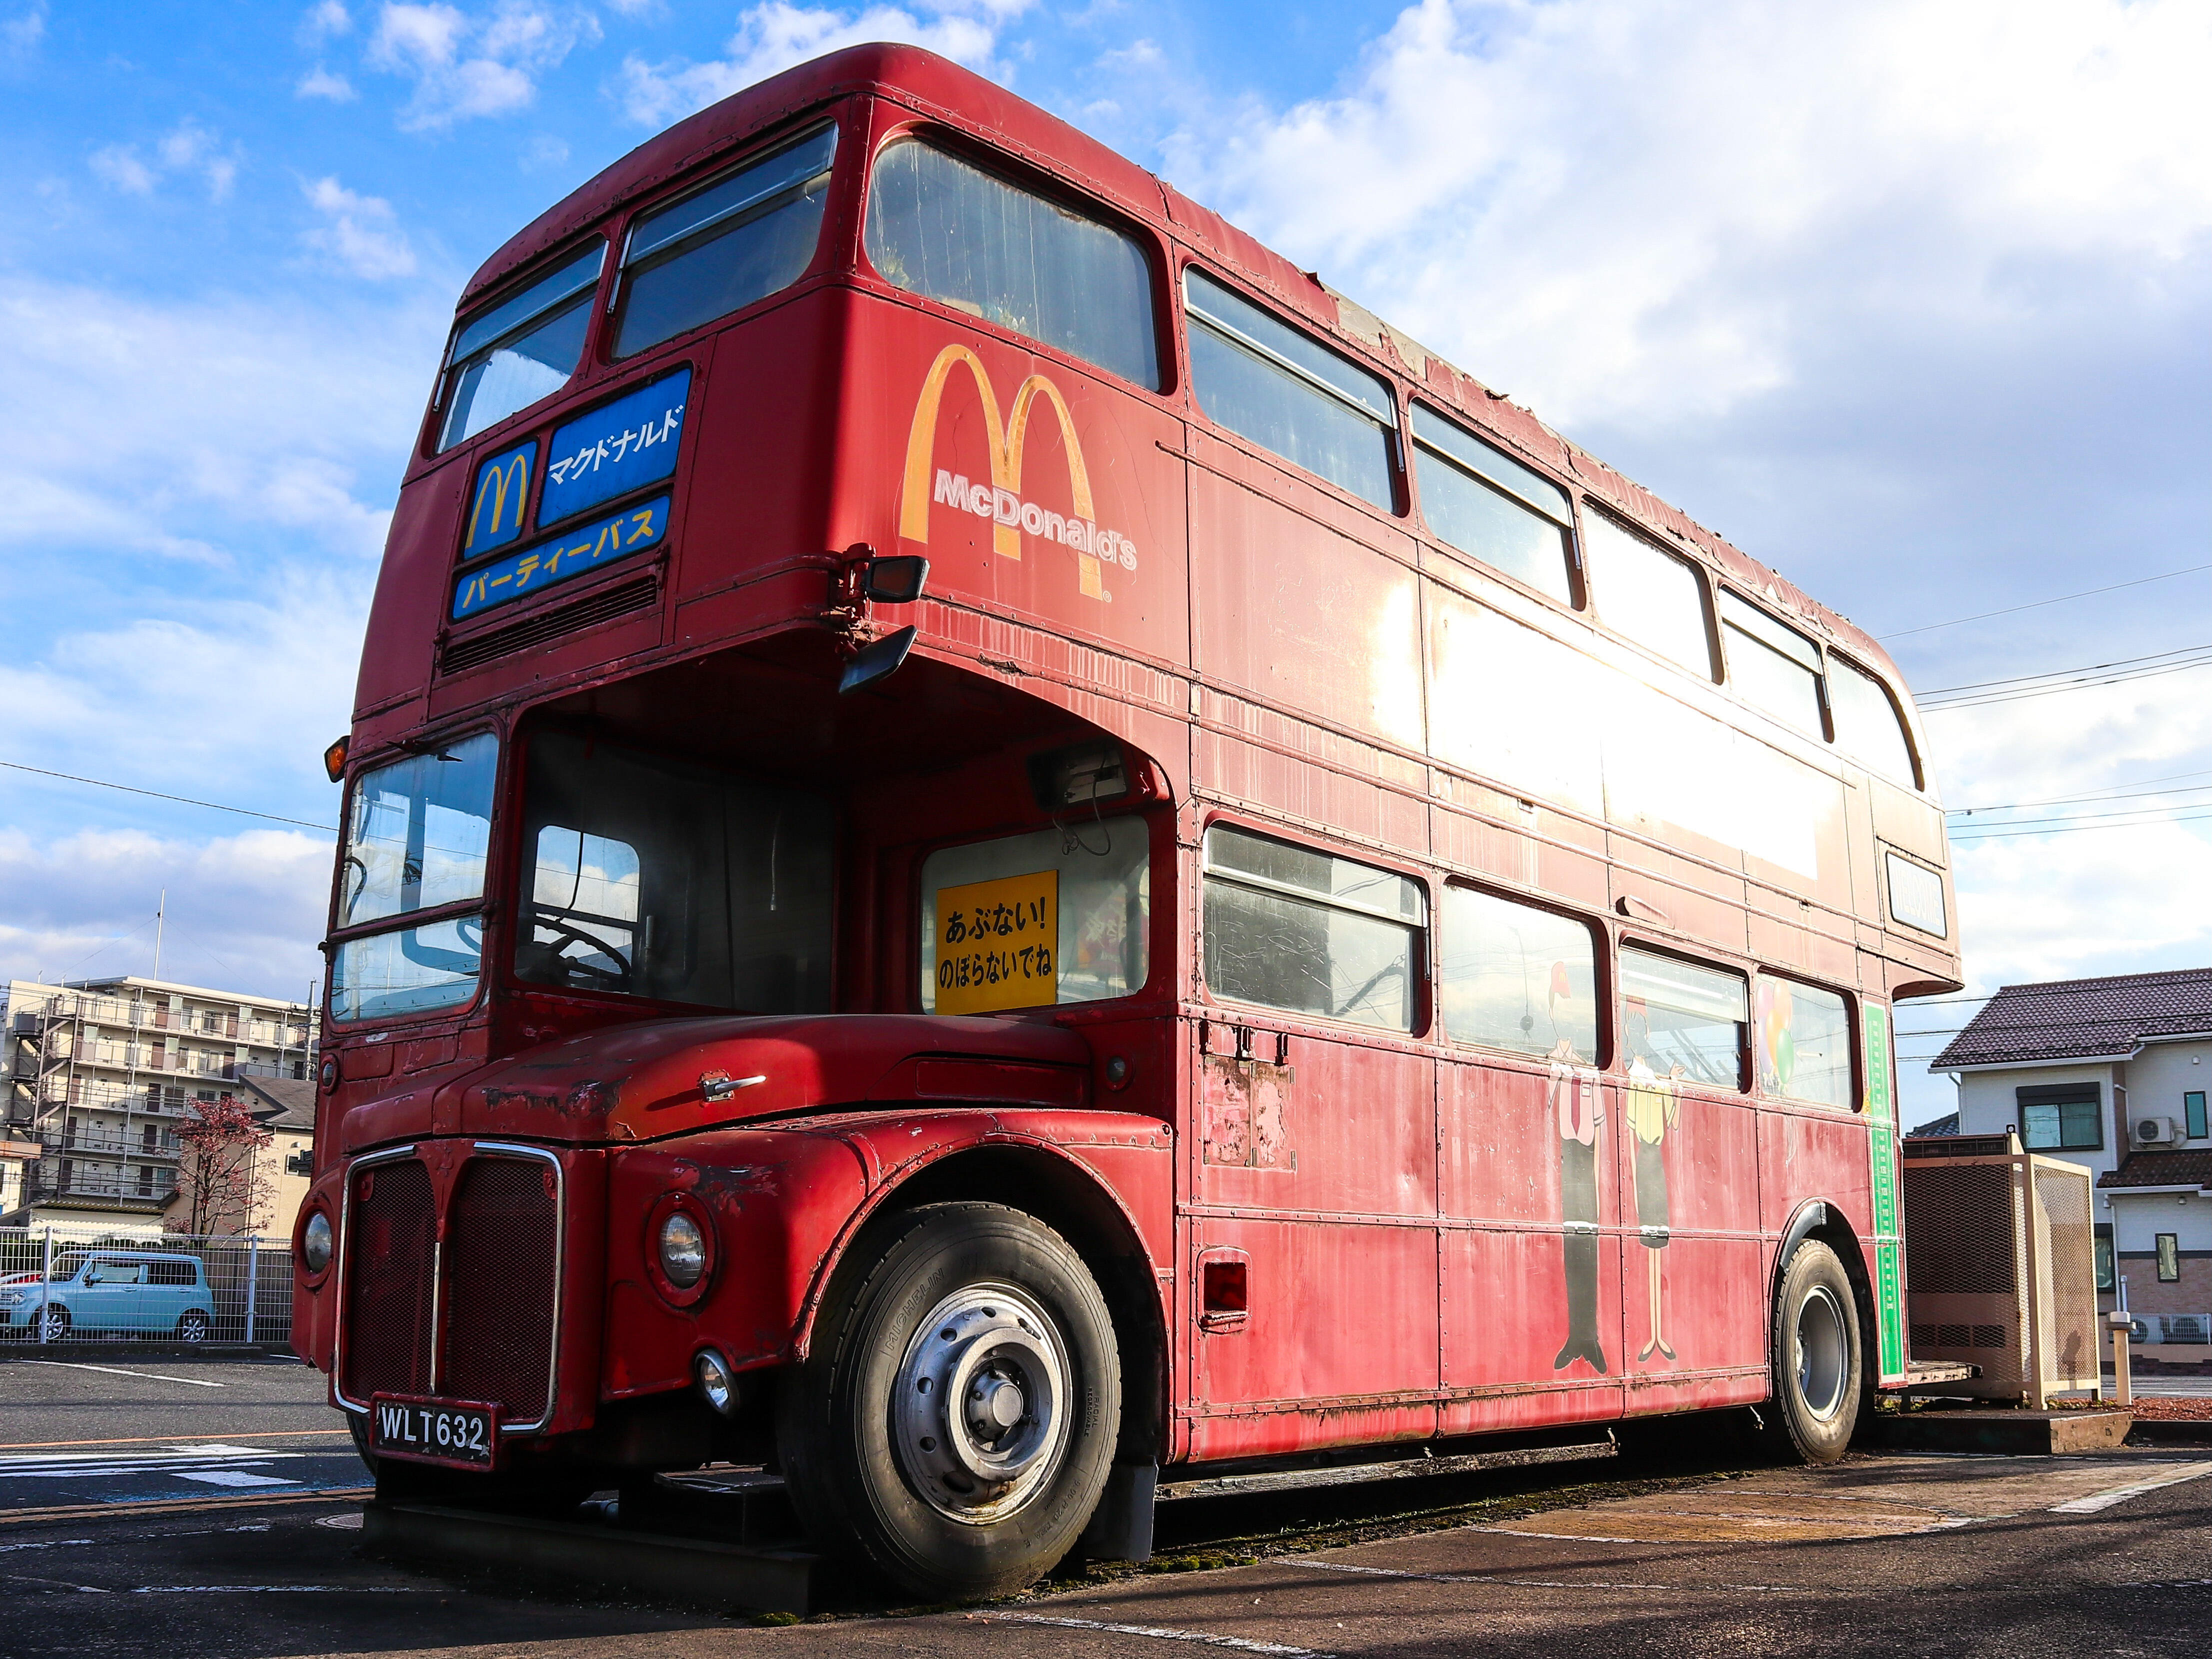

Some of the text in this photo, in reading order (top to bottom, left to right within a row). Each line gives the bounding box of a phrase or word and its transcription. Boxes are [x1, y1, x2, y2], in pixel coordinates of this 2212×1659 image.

[549, 404, 684, 485] マクドナルド
[934, 468, 1137, 570] McDonald's
[462, 509, 653, 608] パーティーバス
[946, 896, 1046, 944] あぶない!
[939, 943, 1052, 990] のぼらないでね
[885, 1268, 944, 1351] MICHELIN
[1084, 1387, 1093, 1438] REGROOVABLE
[1092, 1396, 1100, 1428] RADIAL
